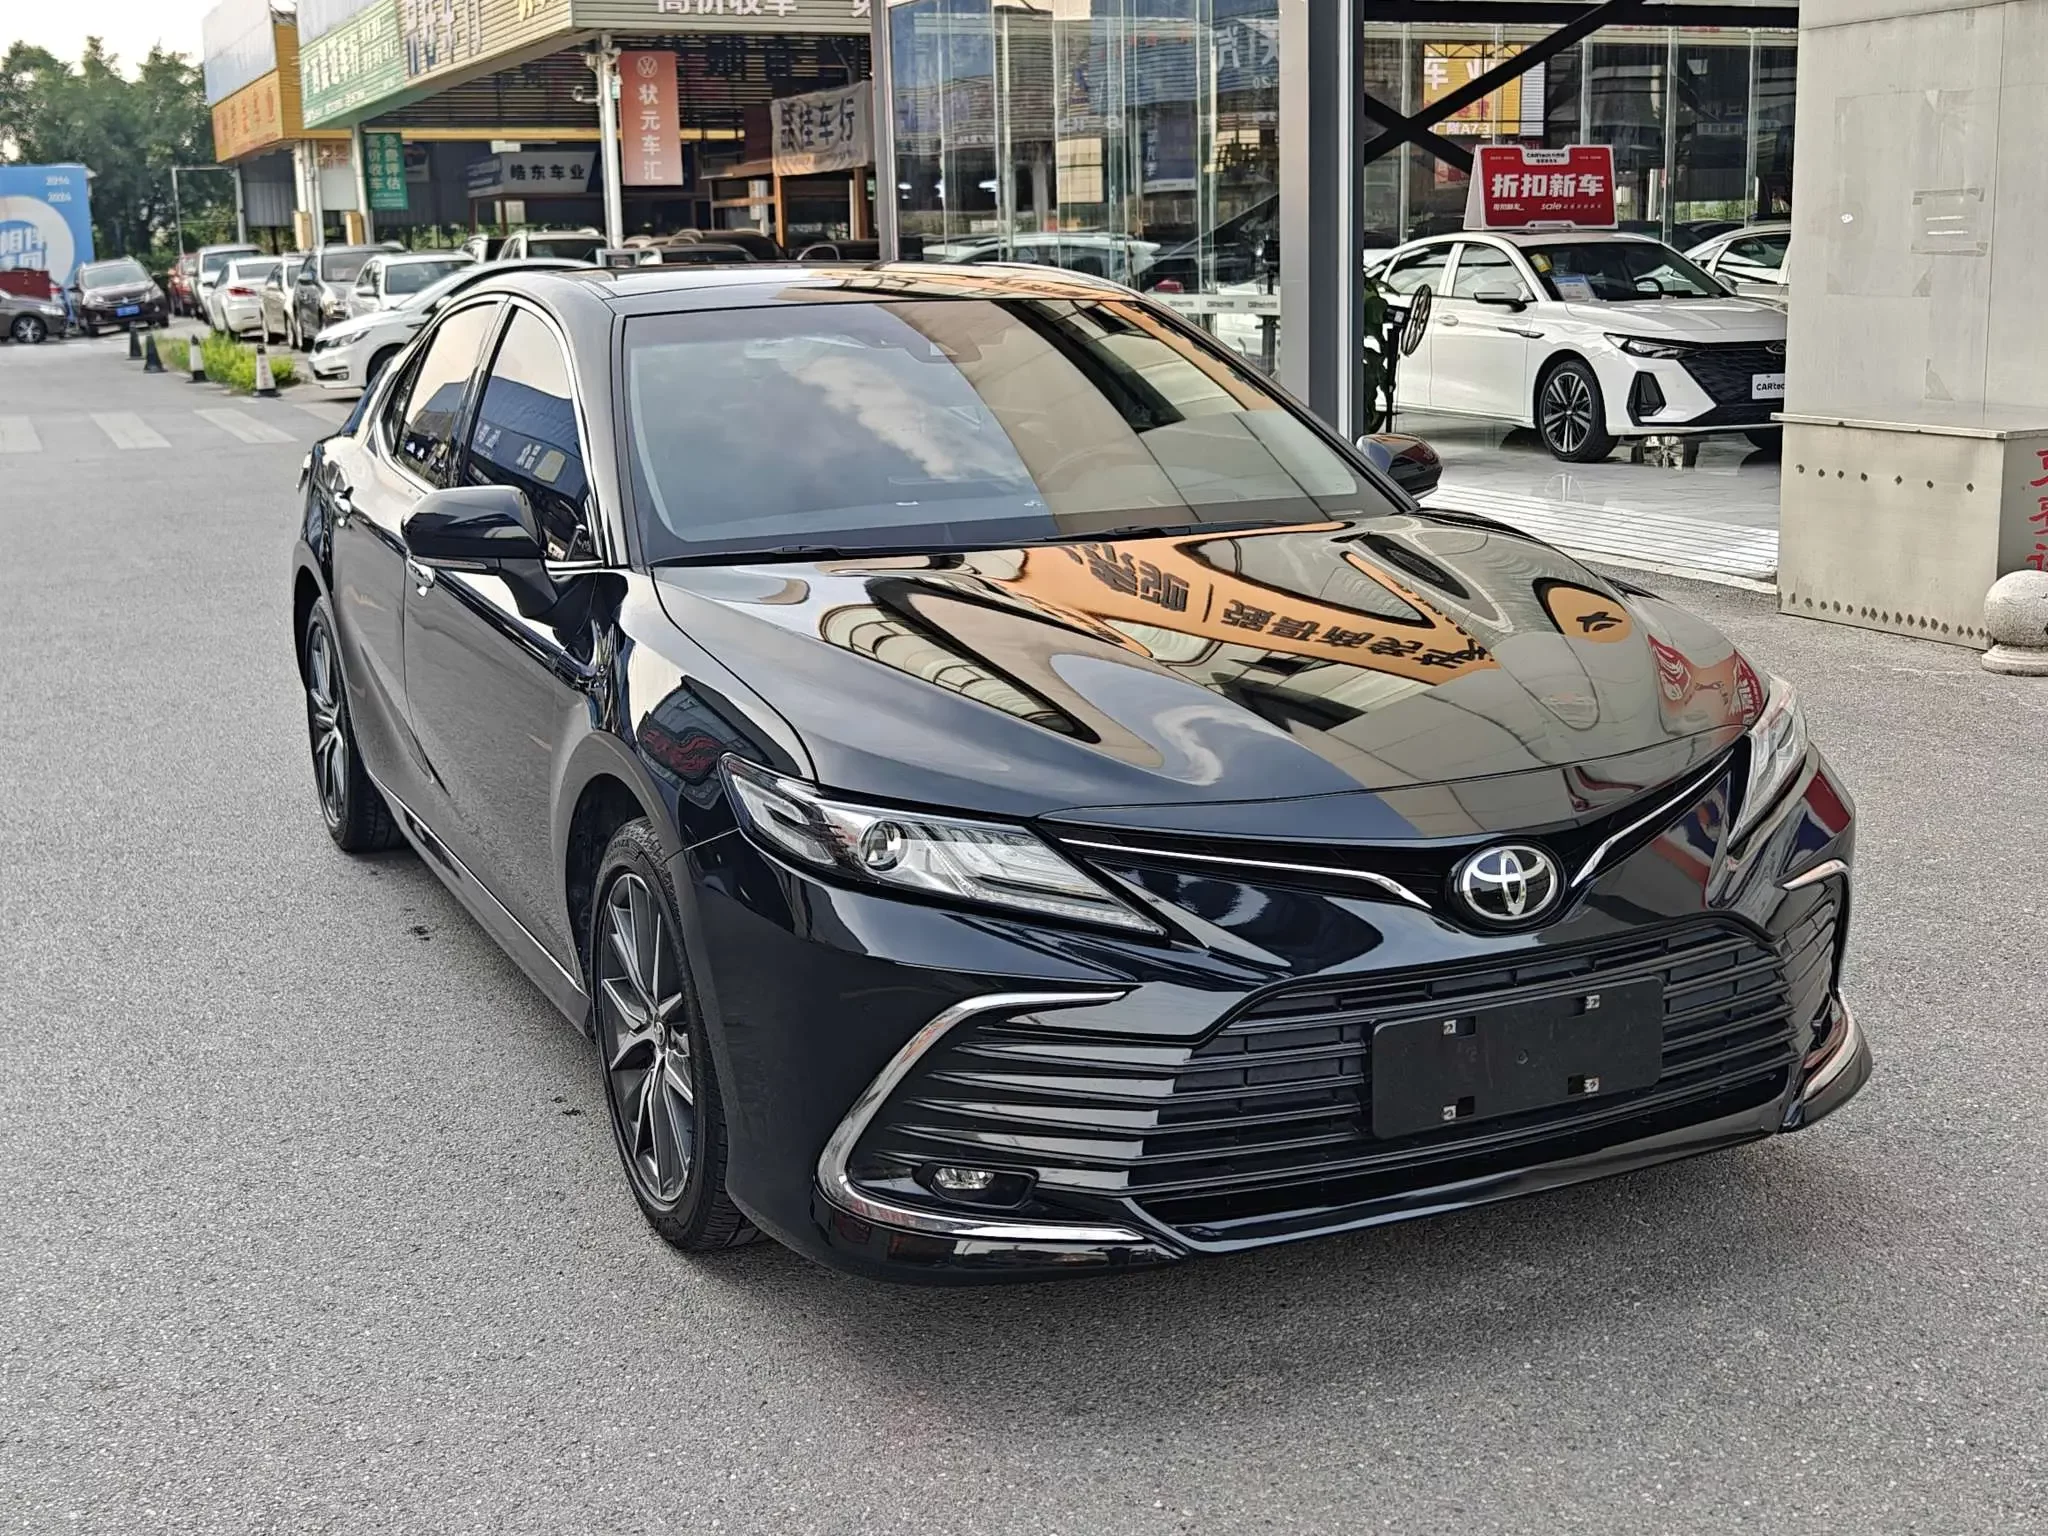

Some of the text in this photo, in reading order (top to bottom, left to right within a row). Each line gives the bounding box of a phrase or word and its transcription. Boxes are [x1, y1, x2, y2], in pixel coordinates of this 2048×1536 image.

[639, 83, 663, 181] 状元车汇
[1491, 172, 1604, 198] 折扣新车
